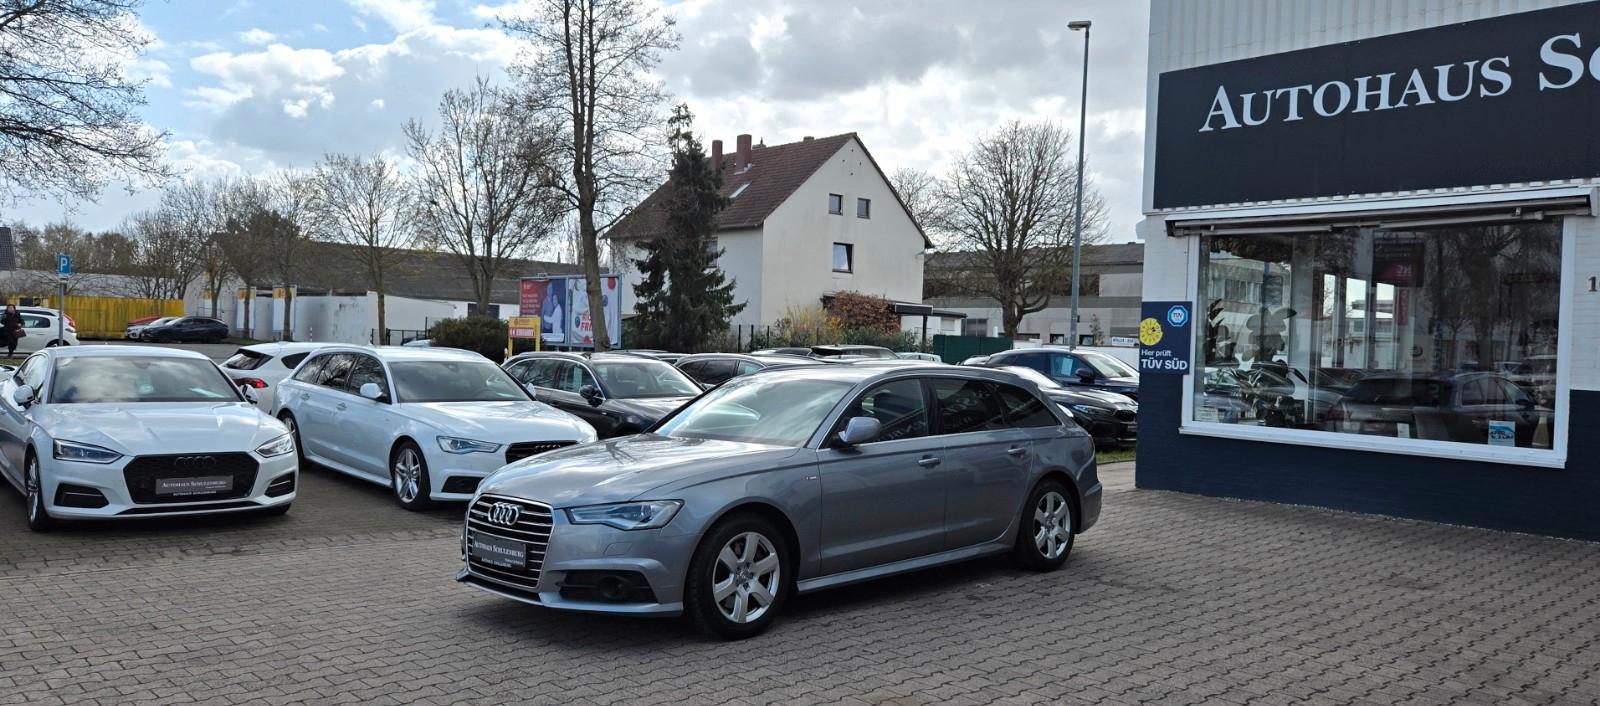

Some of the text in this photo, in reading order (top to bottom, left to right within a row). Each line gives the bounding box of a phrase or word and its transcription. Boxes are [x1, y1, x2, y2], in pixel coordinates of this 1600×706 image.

[1199, 56, 1513, 132] AUTOHAUS
[60, 257, 68, 272] P
[1588, 275, 1600, 292] 1
[1155, 349, 1172, 357] prüft
[1141, 357, 1188, 370] TÜV SÜD
